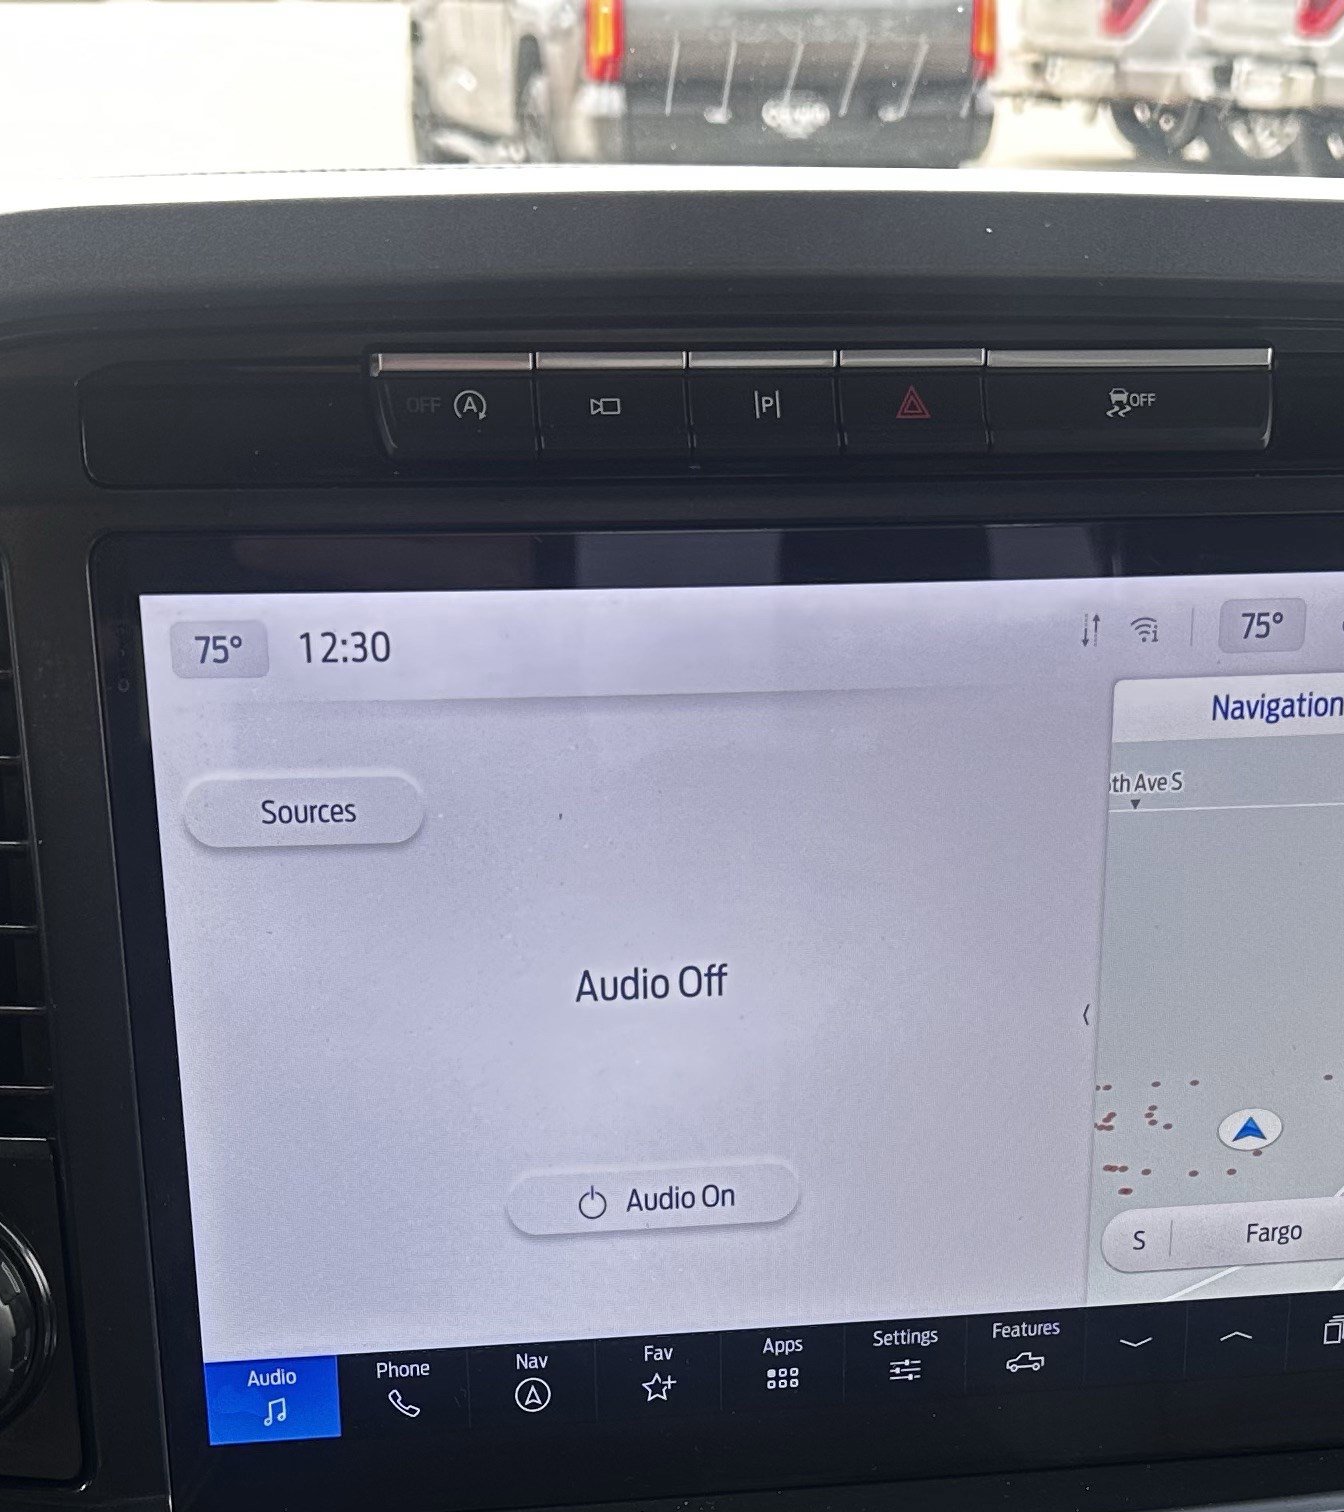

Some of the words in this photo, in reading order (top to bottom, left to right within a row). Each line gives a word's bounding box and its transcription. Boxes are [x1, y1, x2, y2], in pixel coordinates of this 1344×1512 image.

[1129, 392, 1156, 407] OFF
[1241, 611, 1284, 640] 75°
[194, 634, 243, 665] 75°
[299, 630, 391, 664] 12:30
[1211, 690, 1344, 723] Navigation
[1109, 774, 1130, 793] th
[1134, 773, 1168, 792] Ave
[1171, 771, 1183, 791] S
[261, 799, 357, 825] Sources
[575, 966, 670, 1002] Audio
[678, 963, 729, 998] Off
[625, 1186, 696, 1213] Audio
[701, 1184, 736, 1209] On
[1132, 1230, 1146, 1251] S
[1246, 1222, 1303, 1246] Fargo
[872, 1327, 939, 1349] Settings
[992, 1319, 1061, 1340] Features
[643, 1344, 673, 1363] Fav
[762, 1336, 803, 1357] Apps
[376, 1360, 430, 1380] Phone
[516, 1353, 548, 1370] Nav
[247, 1368, 297, 1387] Audio
